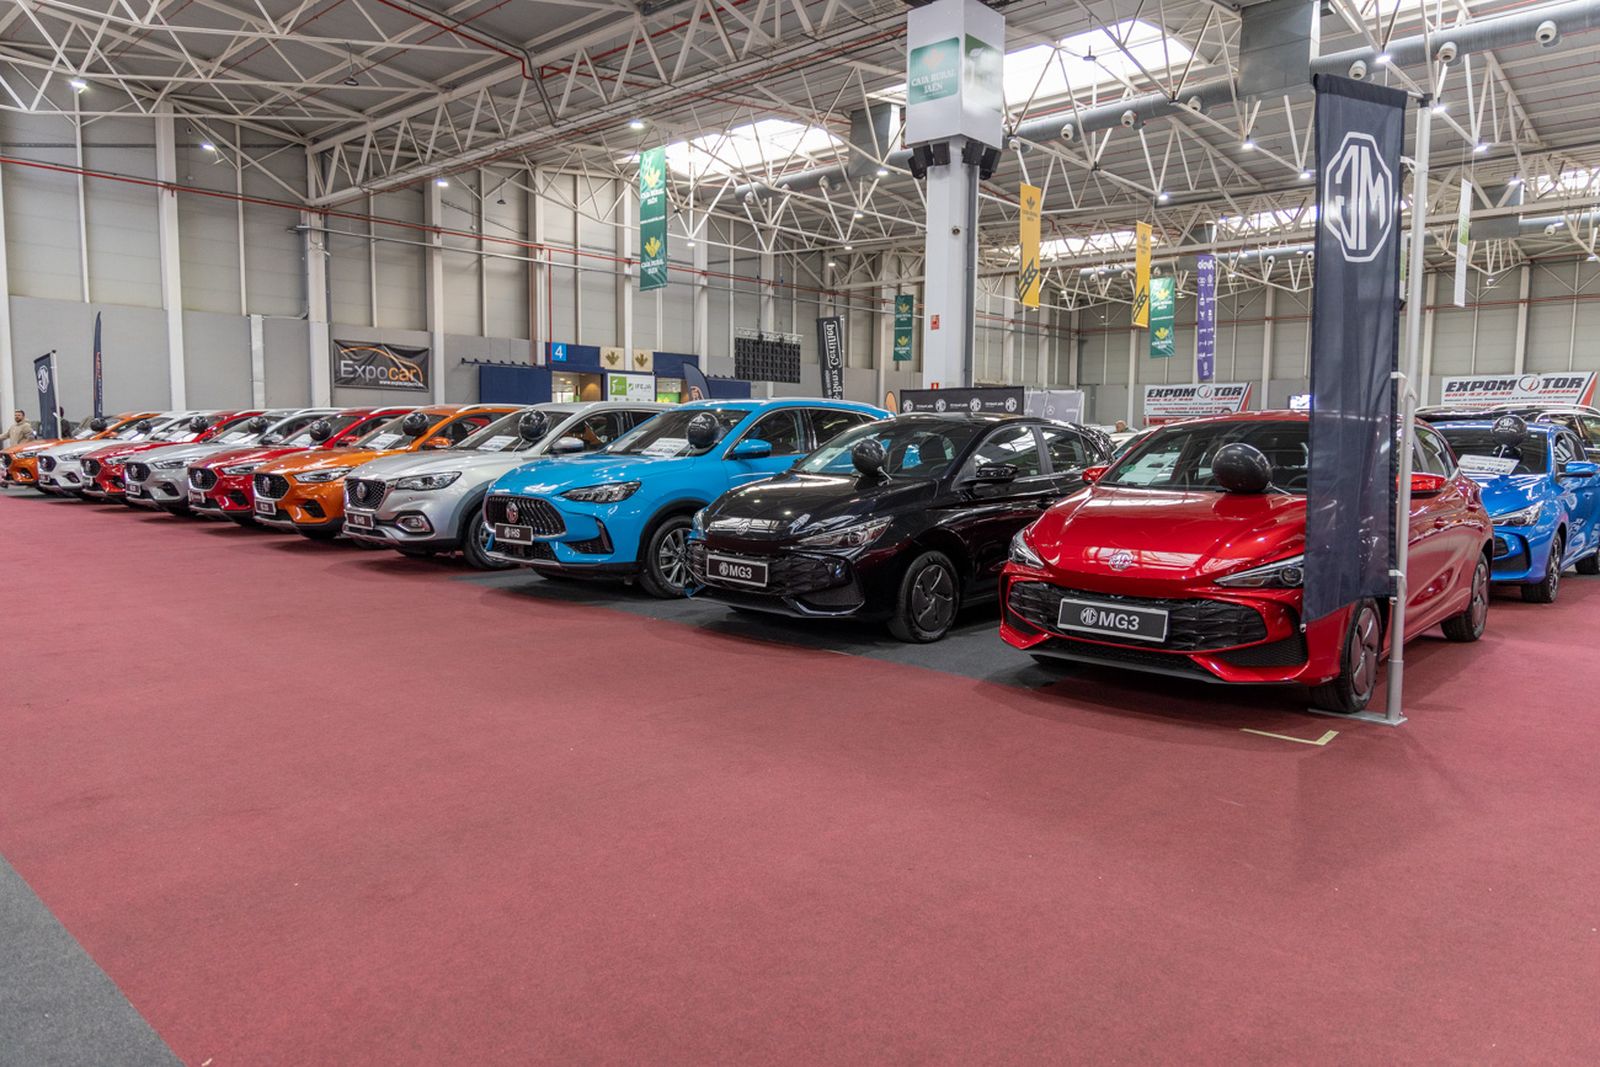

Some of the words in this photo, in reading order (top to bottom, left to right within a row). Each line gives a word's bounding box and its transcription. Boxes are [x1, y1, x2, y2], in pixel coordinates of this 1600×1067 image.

[554, 345, 563, 359] 4
[340, 360, 417, 382] Expocar
[729, 564, 752, 579] MG3
[1098, 611, 1140, 631] MG3
